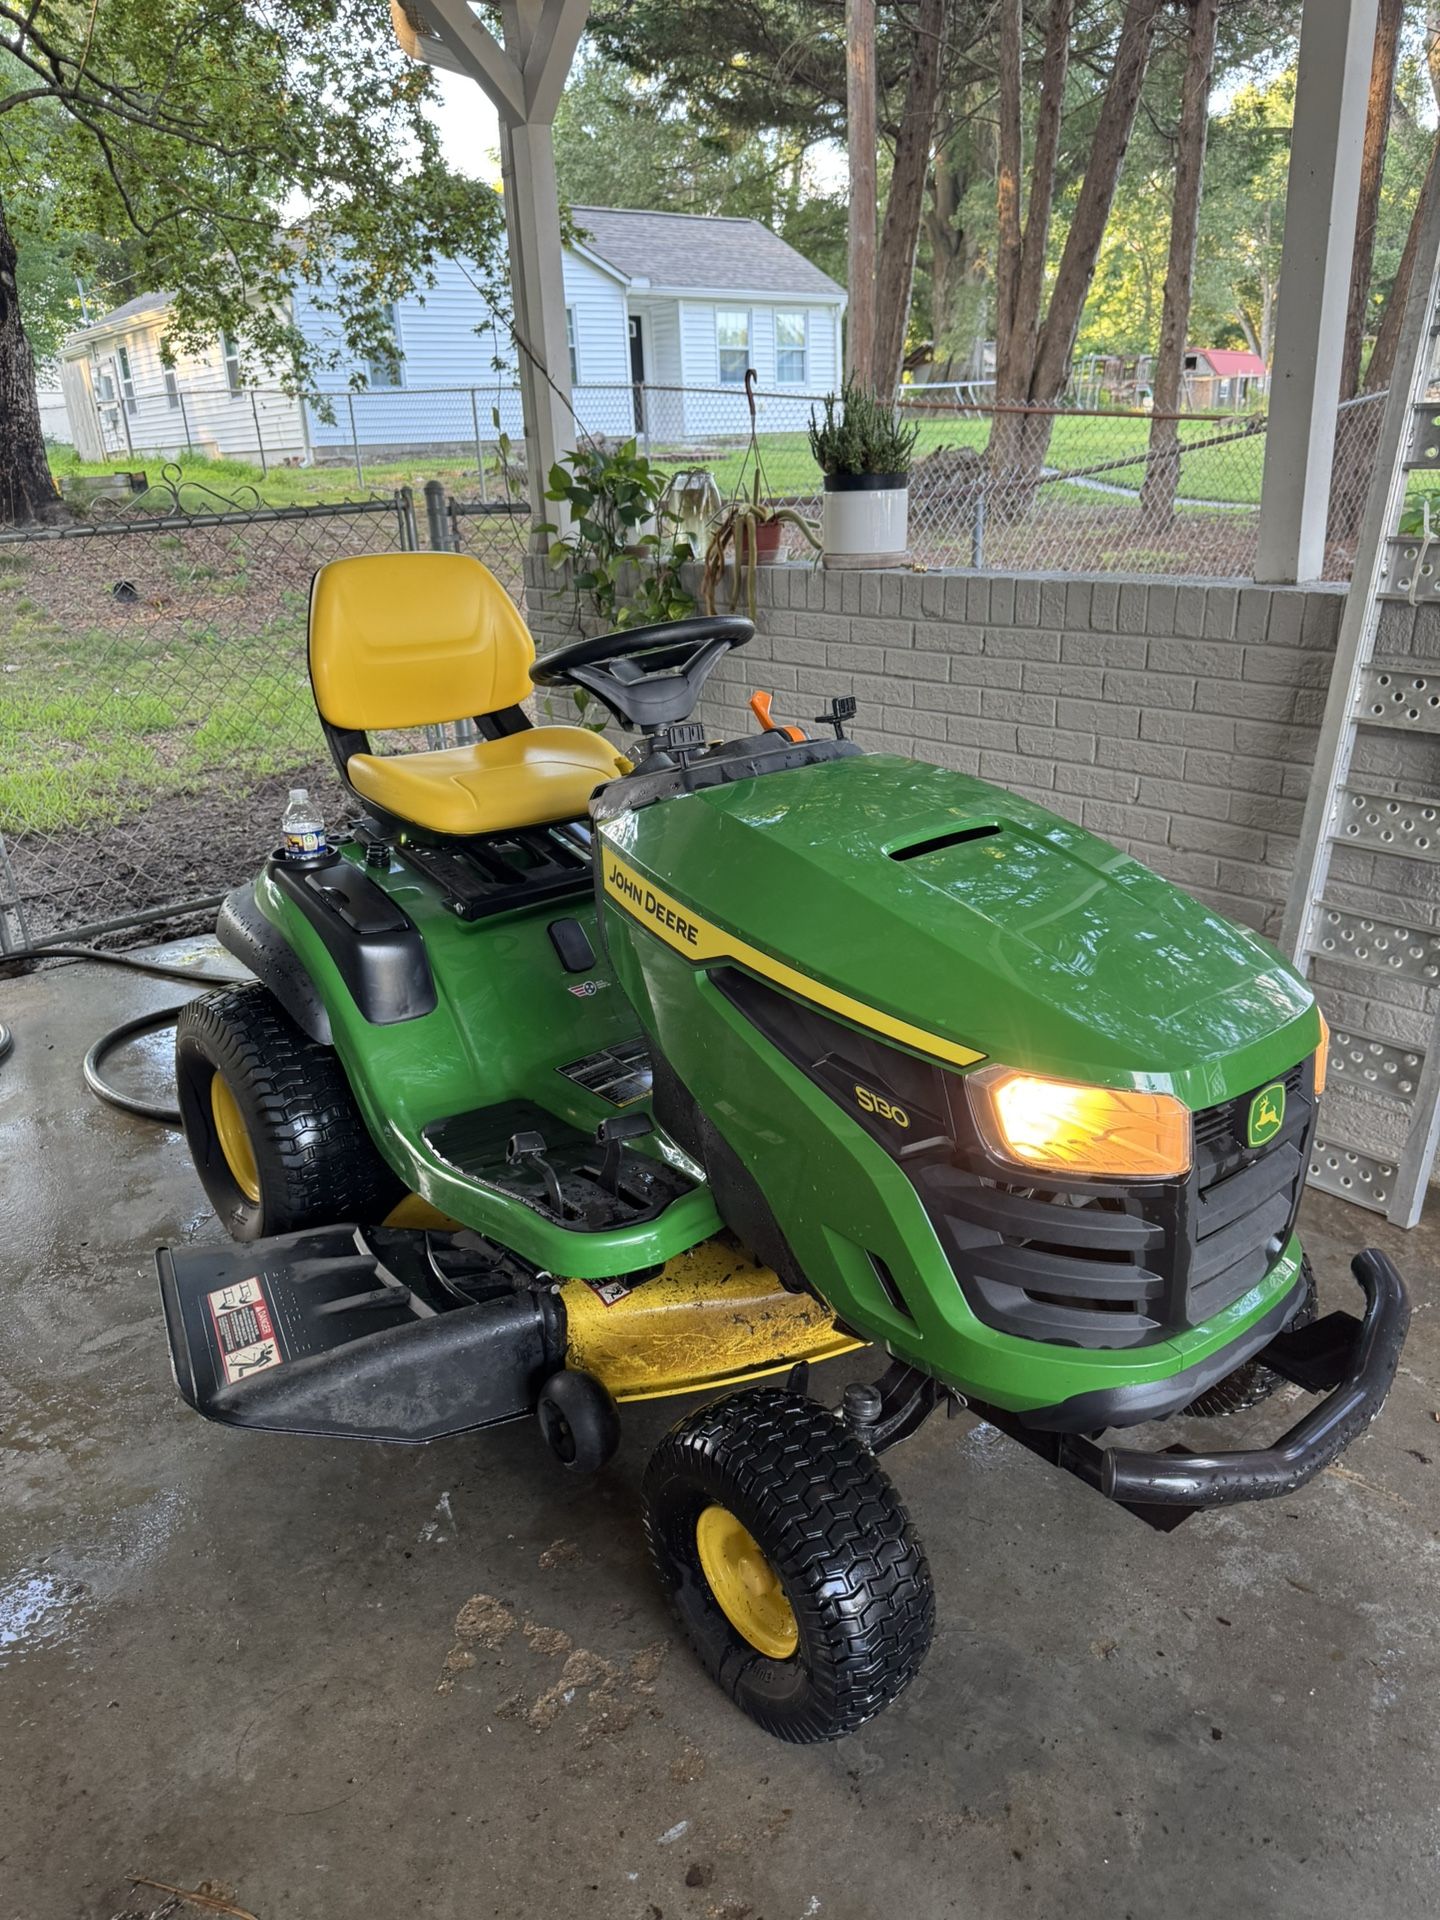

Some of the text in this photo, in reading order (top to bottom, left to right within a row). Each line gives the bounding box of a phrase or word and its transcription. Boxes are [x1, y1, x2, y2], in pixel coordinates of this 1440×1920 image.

[609, 864, 699, 946] JOHN DEERE
[854, 1085, 910, 1129] S130
[257, 1310, 272, 1335] DANGER
